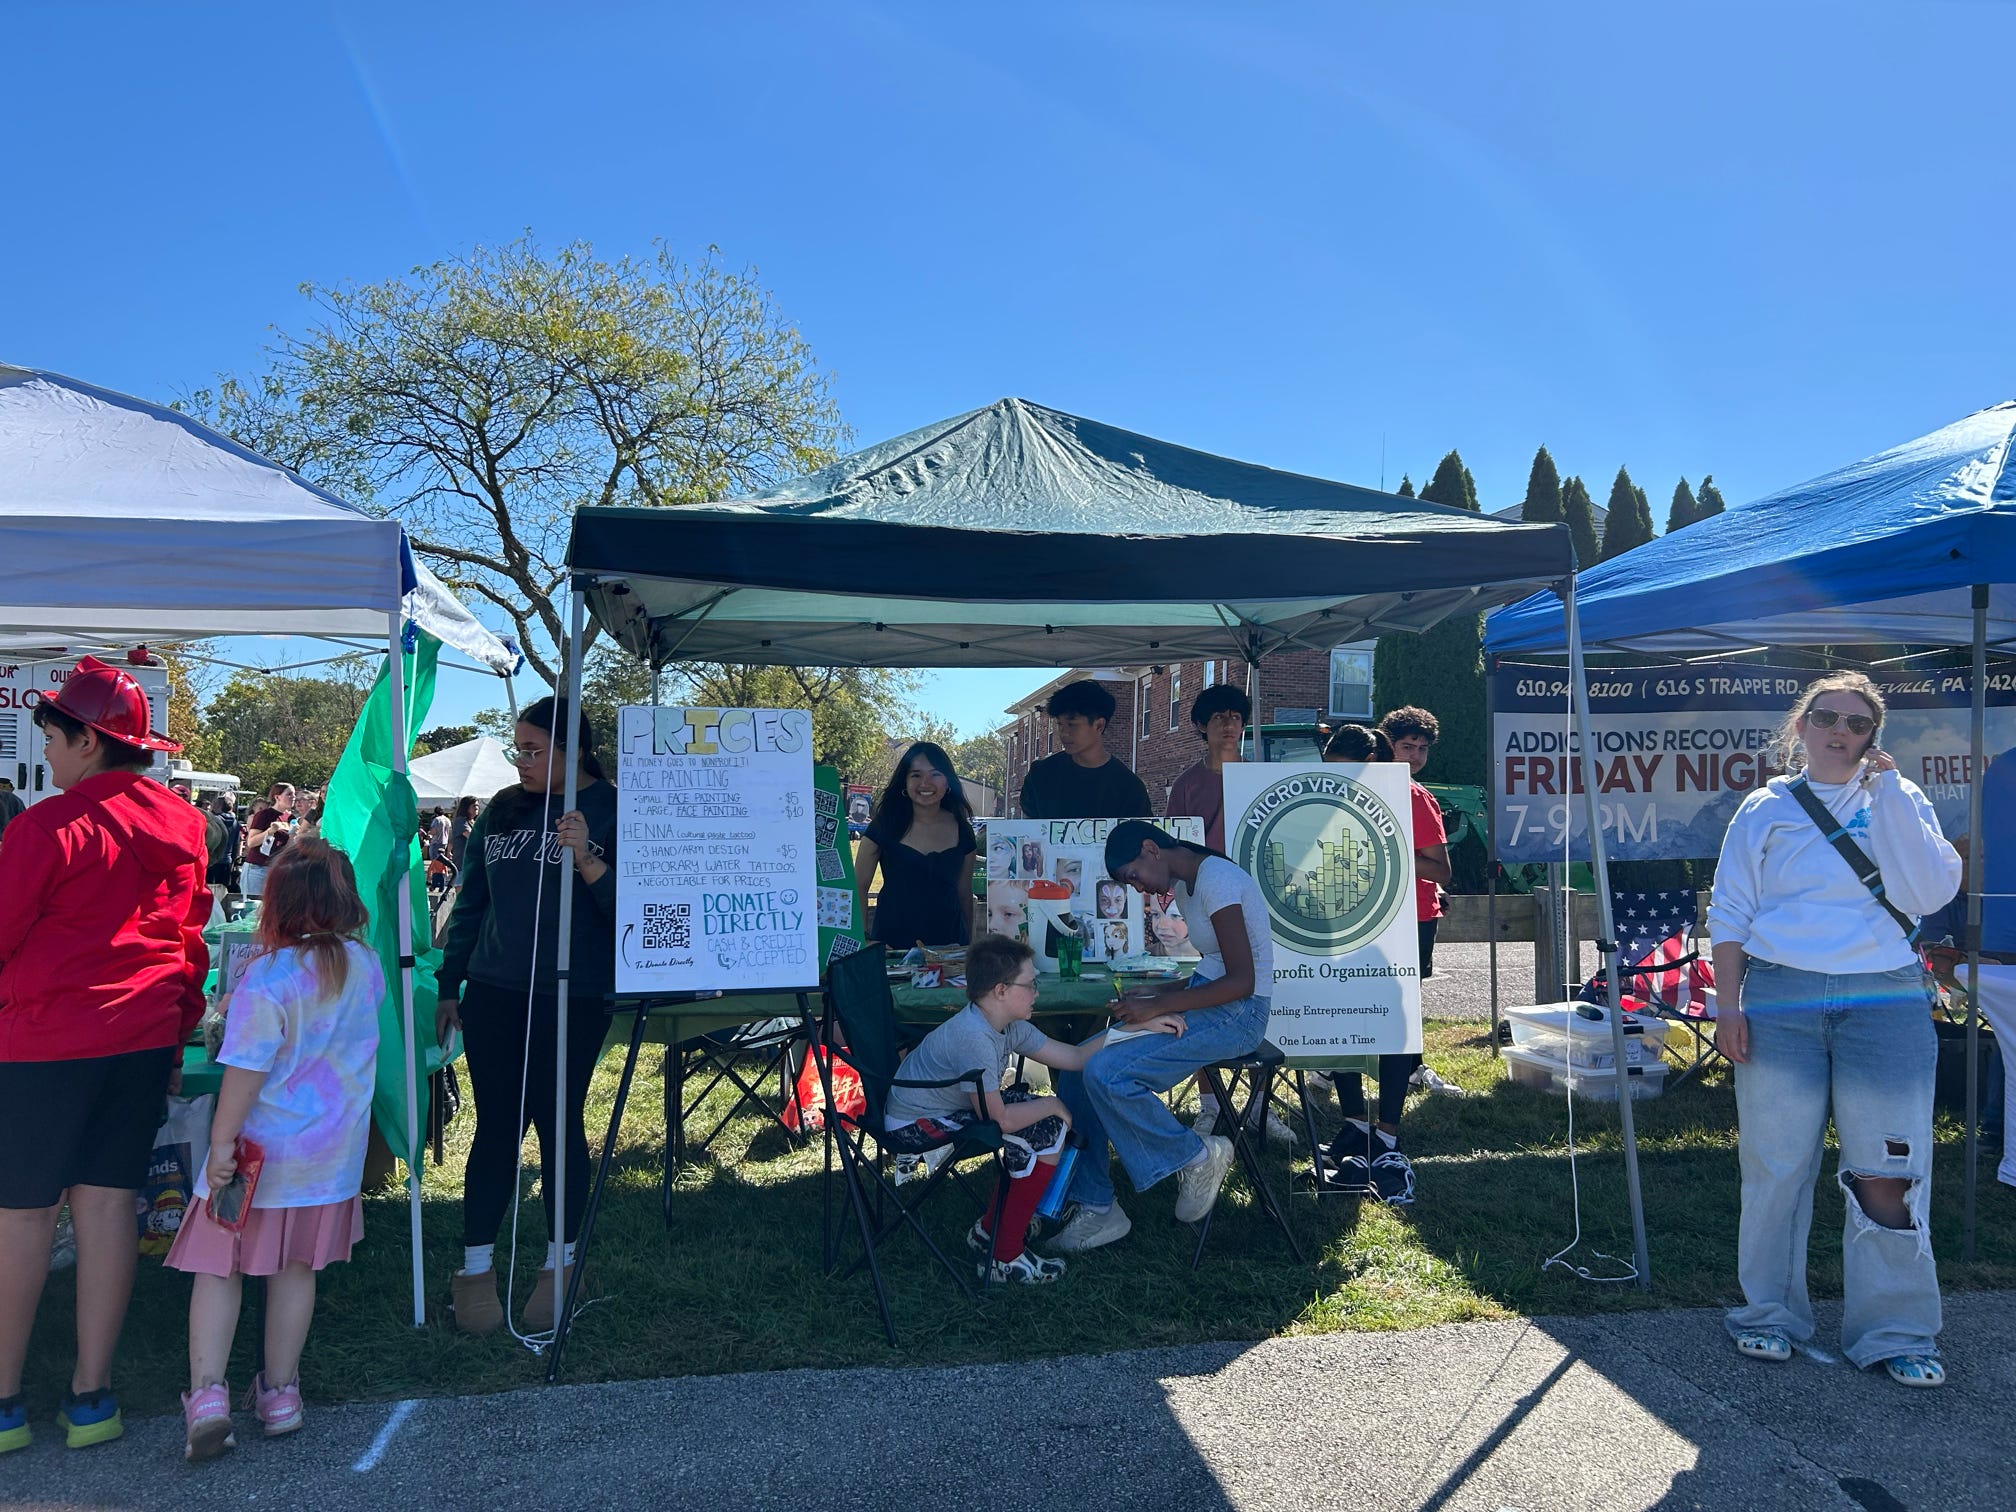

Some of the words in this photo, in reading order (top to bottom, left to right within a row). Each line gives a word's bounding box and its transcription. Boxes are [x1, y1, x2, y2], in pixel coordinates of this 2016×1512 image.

[1655, 679, 1690, 696] 616
[1695, 678, 1705, 695] S
[1710, 678, 1771, 695] TRAPPE
[1941, 677, 1966, 692] PA
[0, 687, 52, 709] SLO
[622, 708, 808, 755] PRICES
[1505, 730, 1658, 753] ADDICIONS
[1663, 728, 1776, 751] RECOVER
[622, 757, 633, 767] ALL
[637, 757, 663, 767] MONEY
[667, 757, 685, 767] GOES
[688, 757, 697, 767] TO
[621, 771, 655, 789] FACE
[661, 768, 729, 788] PAINTING
[1676, 752, 1788, 792] NIGH
[667, 792, 689, 804] FACE
[695, 792, 742, 803] PAINTING
[1923, 784, 1966, 800] THAT
[676, 805, 699, 816] FACE
[703, 805, 749, 816] PAINTING
[1246, 779, 1304, 830] MICRO
[1306, 777, 1350, 799] VRA
[1353, 789, 1396, 837] FUND
[622, 822, 675, 839] HENNA
[1050, 819, 1107, 845] FACE
[641, 845, 650, 858] 3
[708, 845, 750, 855] DESIGN
[705, 859, 741, 872] WATER
[747, 860, 796, 873] TATTOOS
[643, 876, 709, 887] NEGOTIABLE
[712, 875, 731, 886] FOR
[735, 875, 772, 888] PRICES
[702, 891, 779, 914] DONATE
[703, 911, 804, 936] DIRECTLY
[707, 937, 737, 953] CASH
[741, 936, 751, 951] &
[753, 933, 806, 951] CREDIT
[635, 960, 645, 970] To
[645, 959, 668, 969] Donate
[669, 956, 694, 967] Directly
[738, 947, 807, 968] ACCEPTED
[1272, 964, 1314, 983] profit
[1319, 963, 1417, 983] Organization
[1270, 1006, 1301, 1018] ueling
[1303, 1004, 1389, 1017] Entrepreneurship
[1279, 1036, 1300, 1046] One
[1302, 1035, 1328, 1045] Loan
[1329, 1036, 1340, 1045] at
[1350, 1034, 1376, 1045] Time
